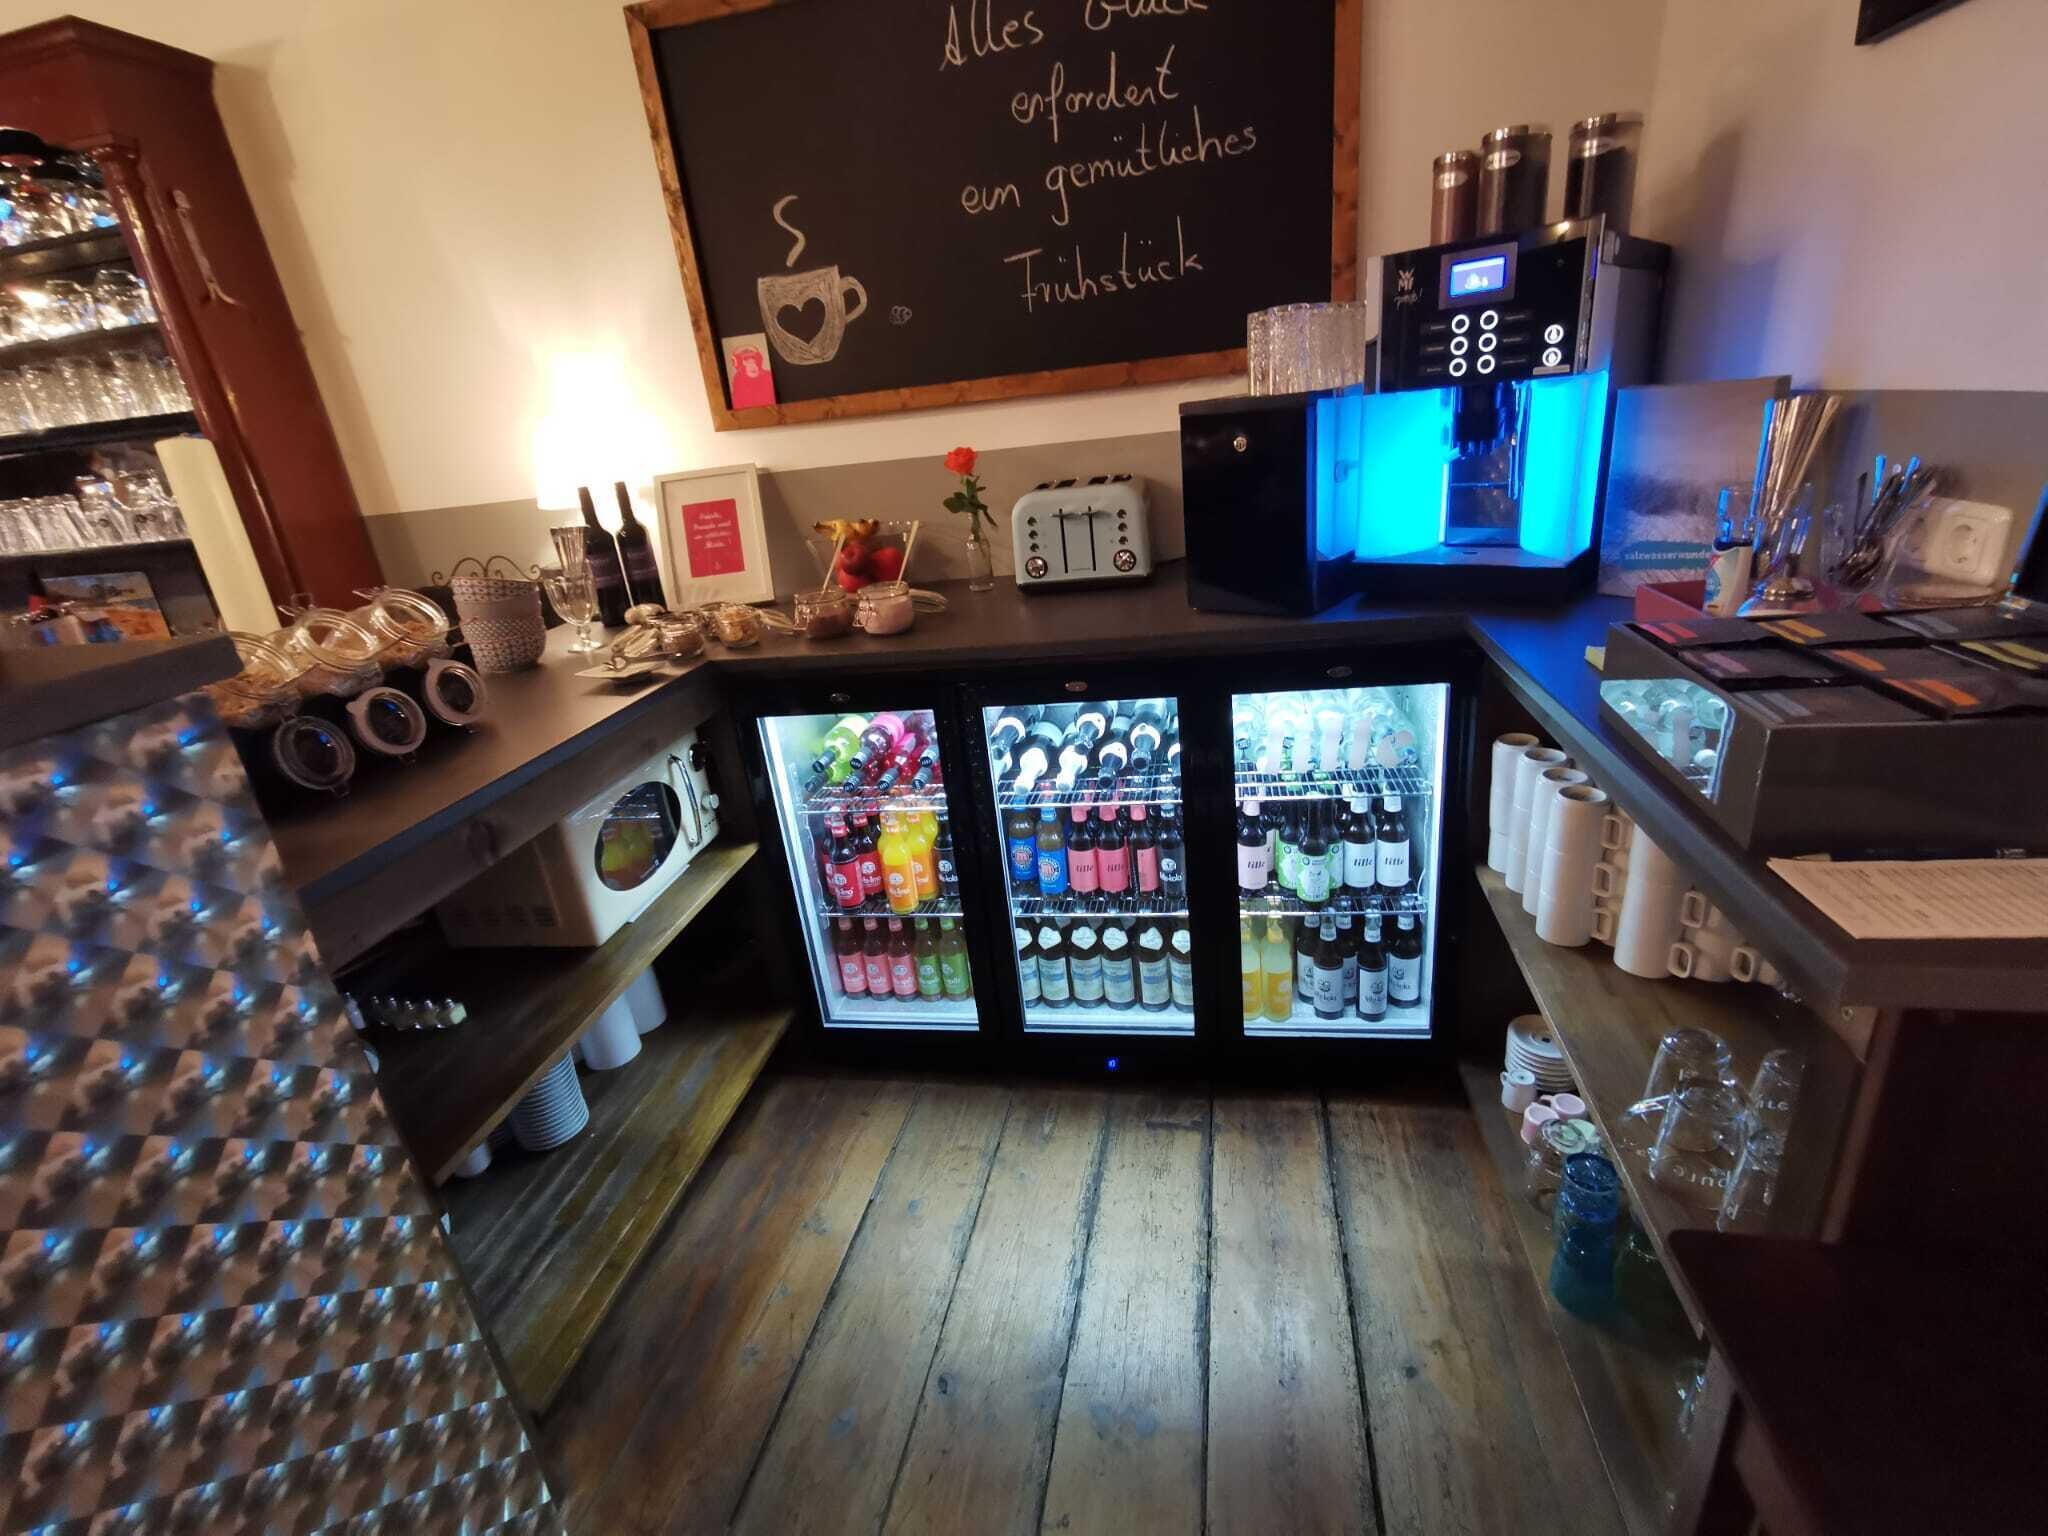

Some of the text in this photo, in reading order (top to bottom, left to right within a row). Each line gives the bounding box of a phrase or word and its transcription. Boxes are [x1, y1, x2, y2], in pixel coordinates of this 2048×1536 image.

[939, 0, 1044, 71] Alles
[1011, 44, 1178, 144] erfordert
[961, 104, 1257, 226] ein gemütliches
[1003, 215, 1204, 313] Frühstück
